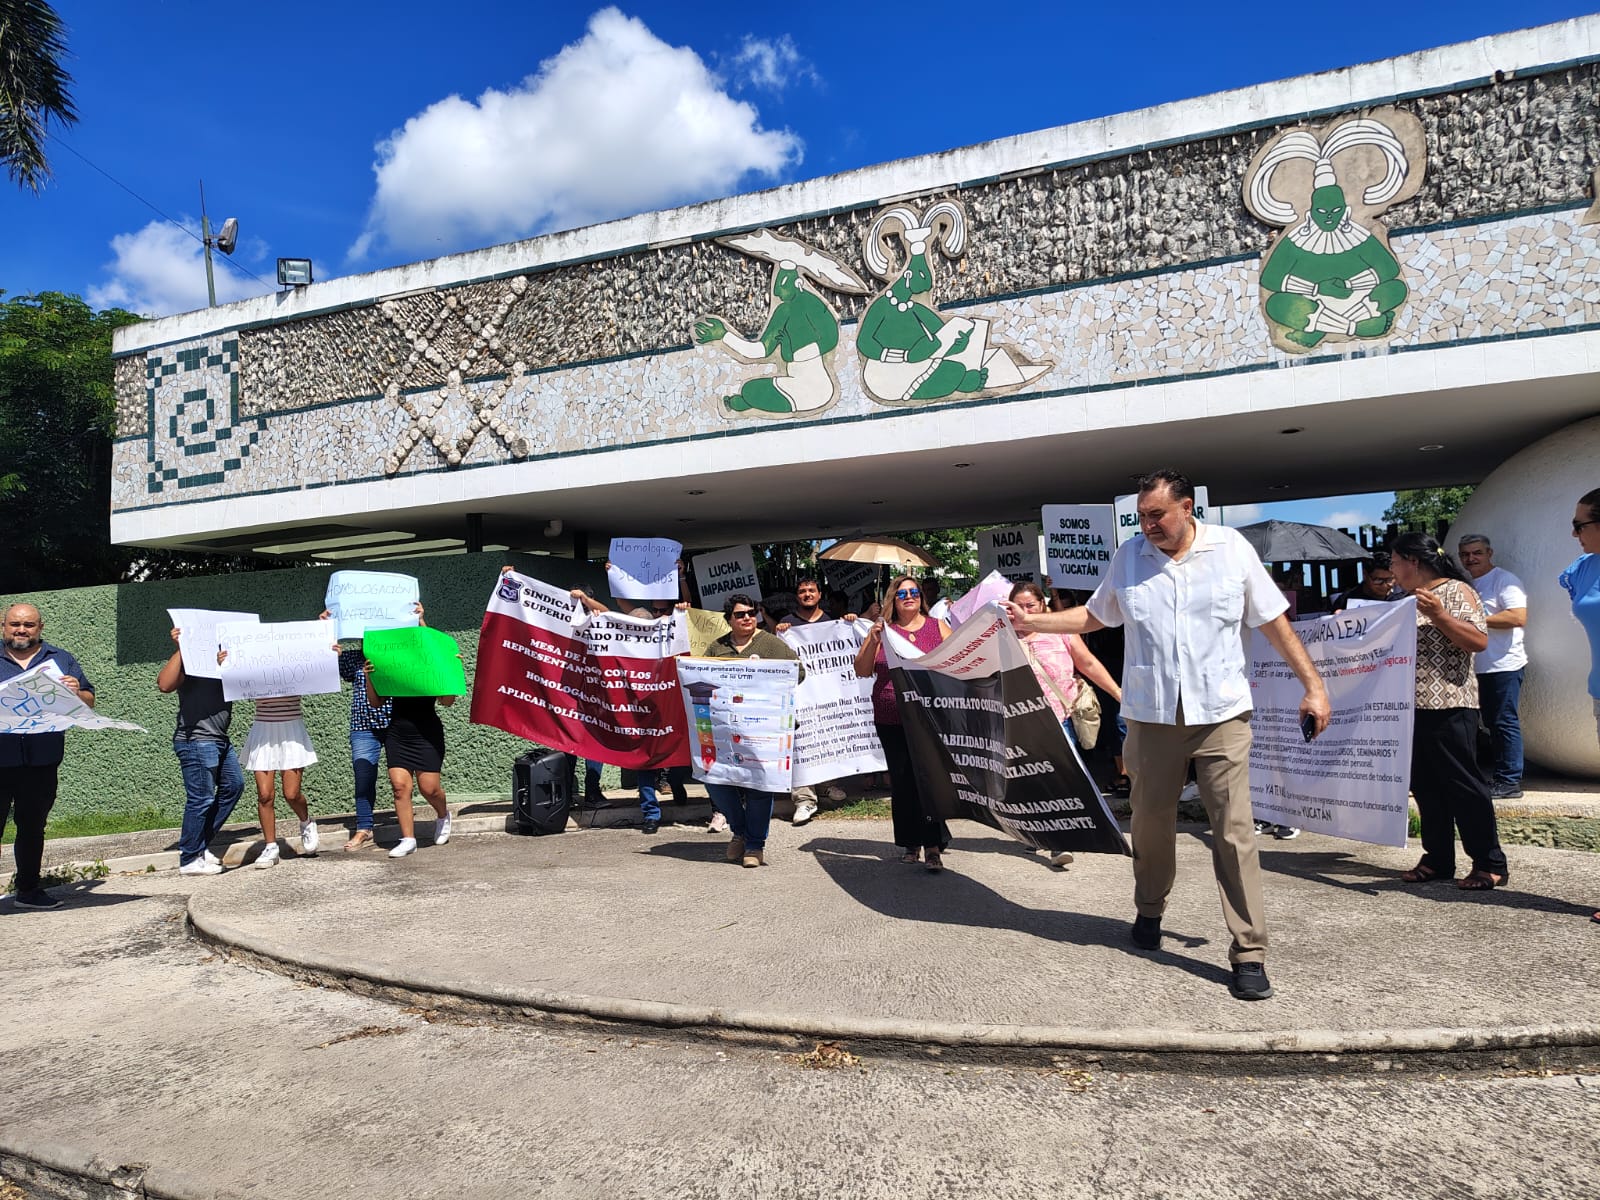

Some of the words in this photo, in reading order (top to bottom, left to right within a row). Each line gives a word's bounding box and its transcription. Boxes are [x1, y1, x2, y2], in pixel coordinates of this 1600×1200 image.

[1059, 518, 1090, 530] SOMOS
[992, 531, 1024, 547] NADA
[1050, 533, 1076, 545] PARTE
[1078, 534, 1090, 545] DE
[1092, 534, 1104, 546] LA
[997, 553, 1021, 568] NOS
[1048, 547, 1096, 561] EDUCACIÓN
[1098, 550, 1110, 562] EN
[641, 558, 651, 569] de
[709, 561, 742, 578] LUCHA
[1060, 563, 1099, 576] YUCATÁN
[702, 574, 756, 597] IMPARABLE
[523, 588, 576, 613] SINDICAT
[606, 621, 623, 630] DE
[522, 600, 571, 623] SUPERIO
[615, 633, 631, 642] DE
[1336, 618, 1367, 639] LEAL
[797, 639, 845, 657] INDICATO
[502, 639, 584, 675] REPRESENTAN
[600, 679, 630, 689] CADA
[630, 679, 676, 691] SECCIÓN
[530, 639, 562, 655] MESA
[564, 650, 581, 662] DE
[604, 669, 628, 678] CON
[629, 670, 652, 679] LOS
[757, 667, 790, 675] maestros
[1338, 663, 1378, 676] Universidade
[497, 685, 547, 708] APLICAR
[548, 703, 599, 725] POLÍTICA
[599, 720, 613, 732] DEL
[613, 725, 674, 737] BIENESTAR
[933, 697, 980, 710] CONTRATO
[981, 699, 1004, 714] COLECTI
[1002, 695, 1051, 718] RABAJO
[1373, 714, 1399, 723] personas
[939, 734, 985, 749] ABILIDAD
[951, 753, 988, 770] ADORES
[995, 797, 1085, 814] TRABAJADORES
